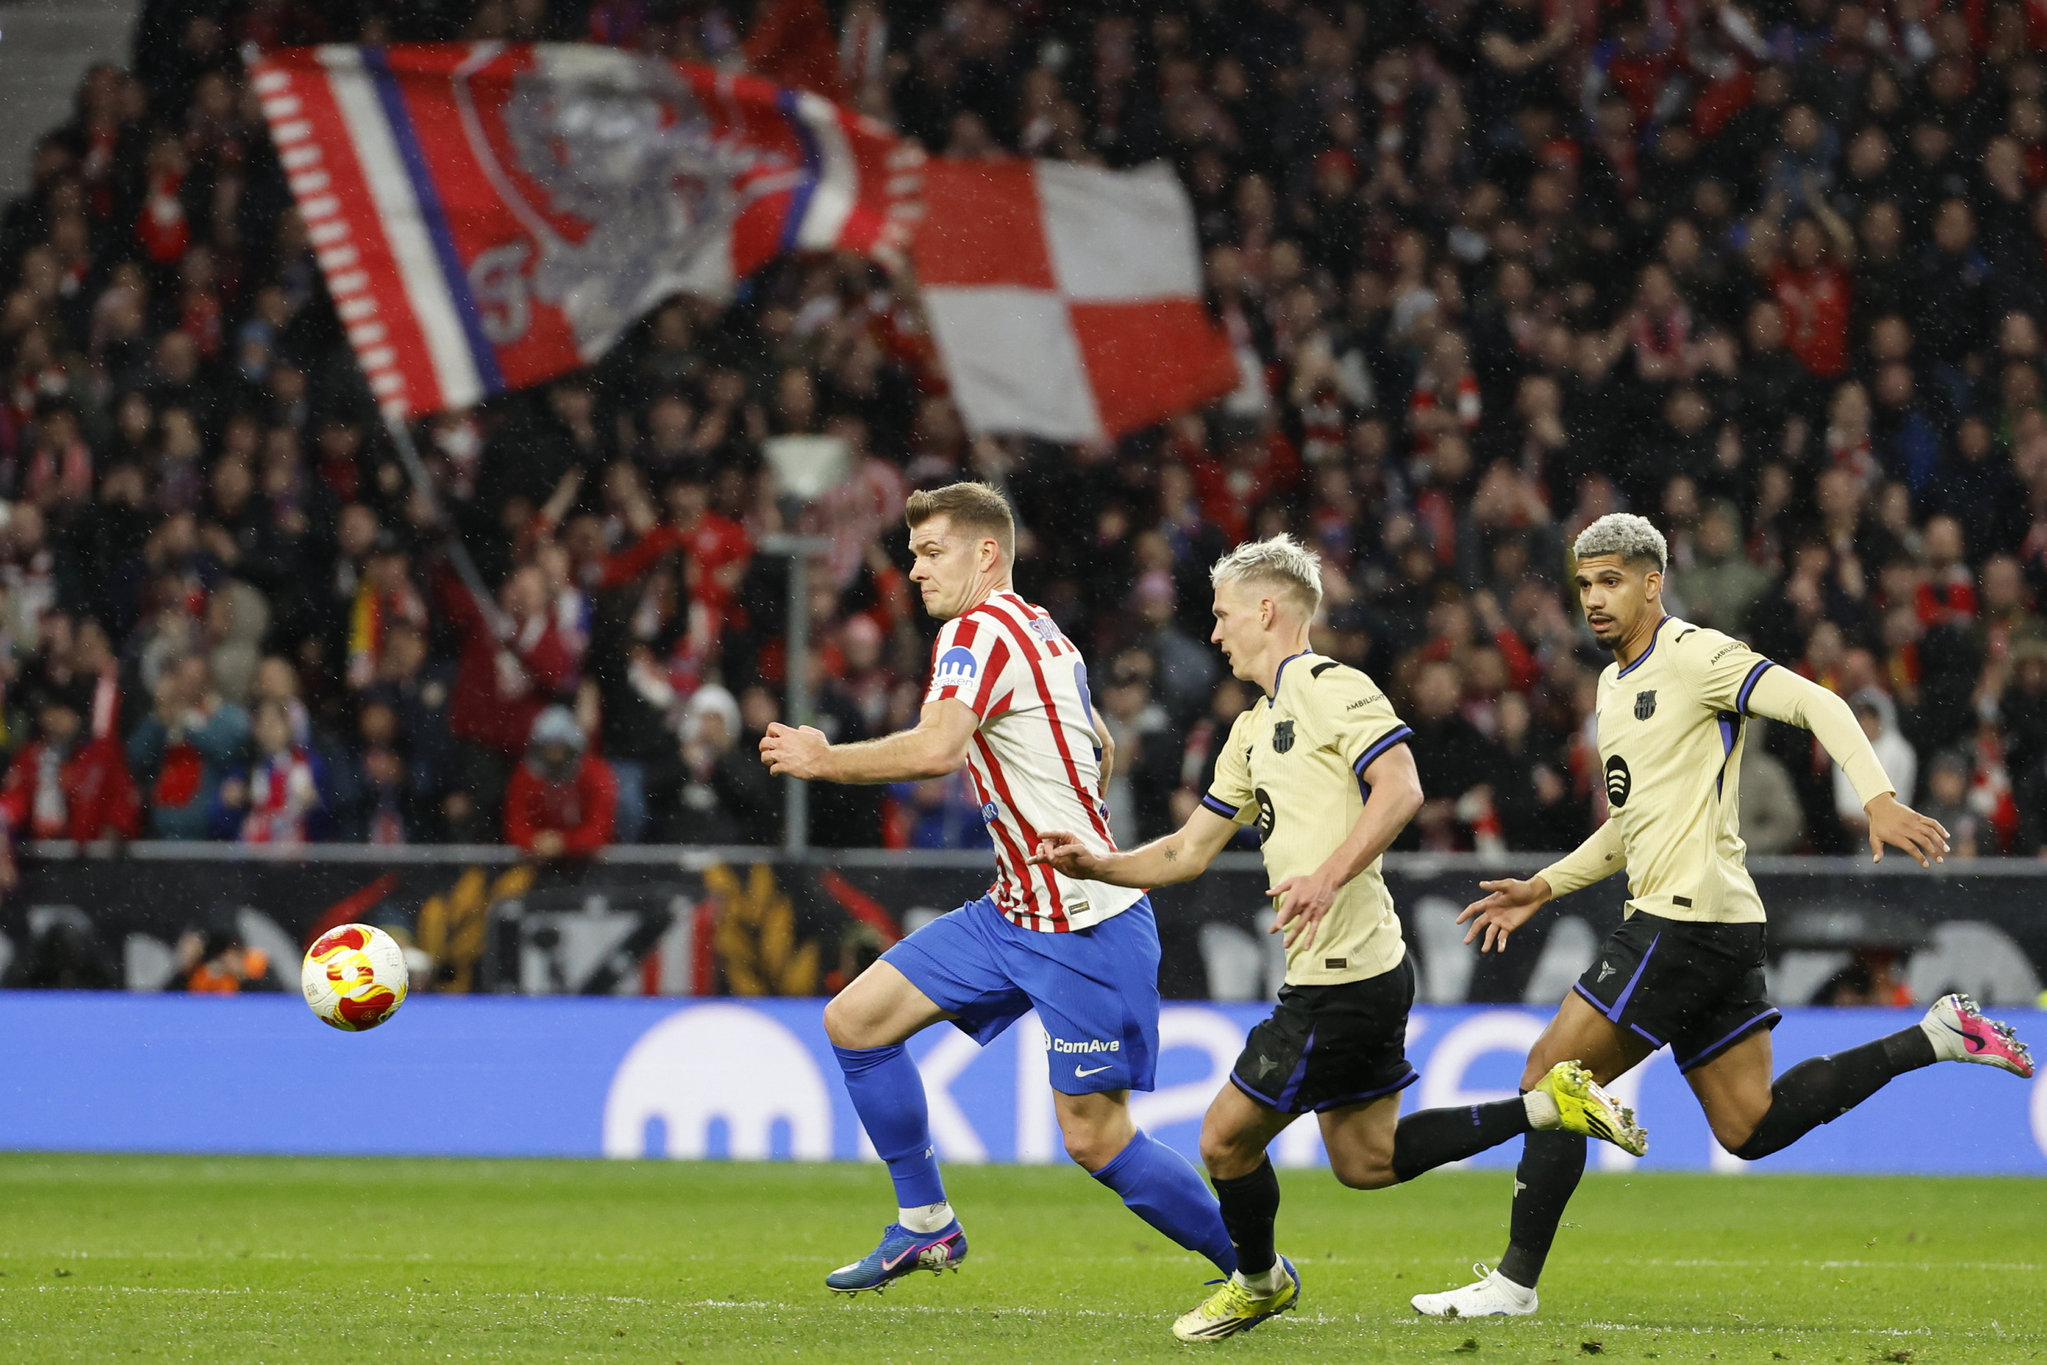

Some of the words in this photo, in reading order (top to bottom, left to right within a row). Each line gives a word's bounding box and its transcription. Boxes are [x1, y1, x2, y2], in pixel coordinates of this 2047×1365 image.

[1710, 643, 1742, 666] AMBILIGH
[933, 677, 973, 688] kraken
[981, 803, 997, 823] AIR
[1054, 1038, 1119, 1053] ComAve
[857, 1006, 1748, 1172] krae
